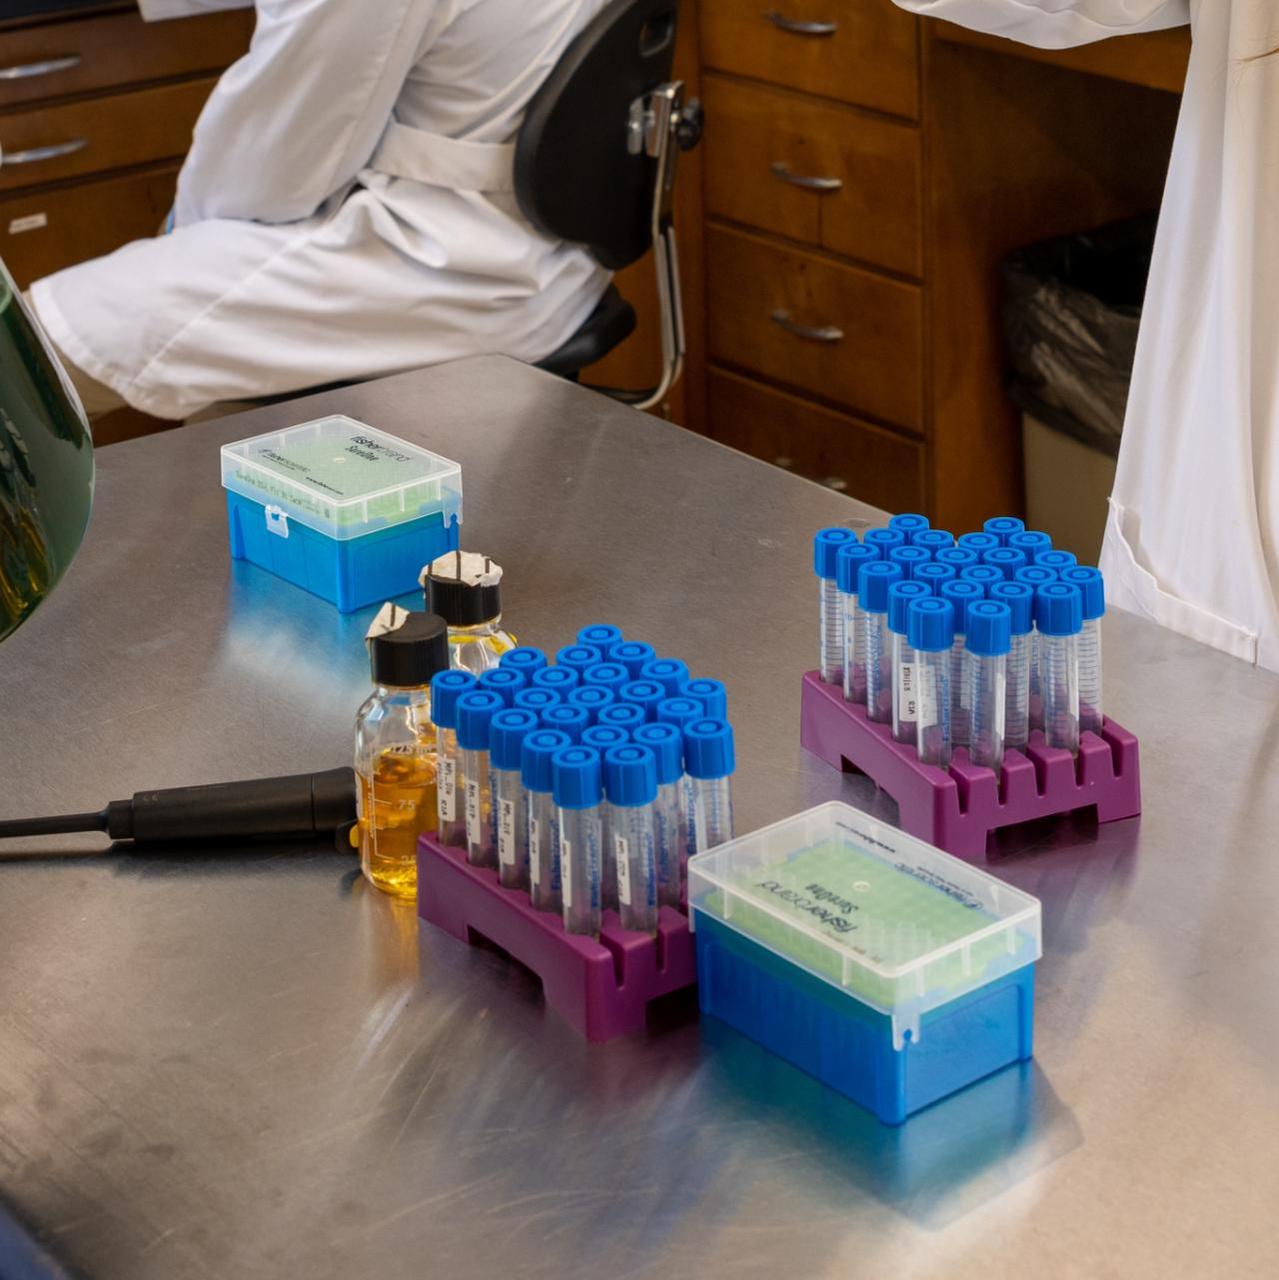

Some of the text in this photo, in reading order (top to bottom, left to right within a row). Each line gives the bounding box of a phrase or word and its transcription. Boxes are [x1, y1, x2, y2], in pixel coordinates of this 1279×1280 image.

[398, 799, 415, 810] 75
[756, 880, 858, 933] fisherbrand
[805, 882, 859, 913] SureOne
